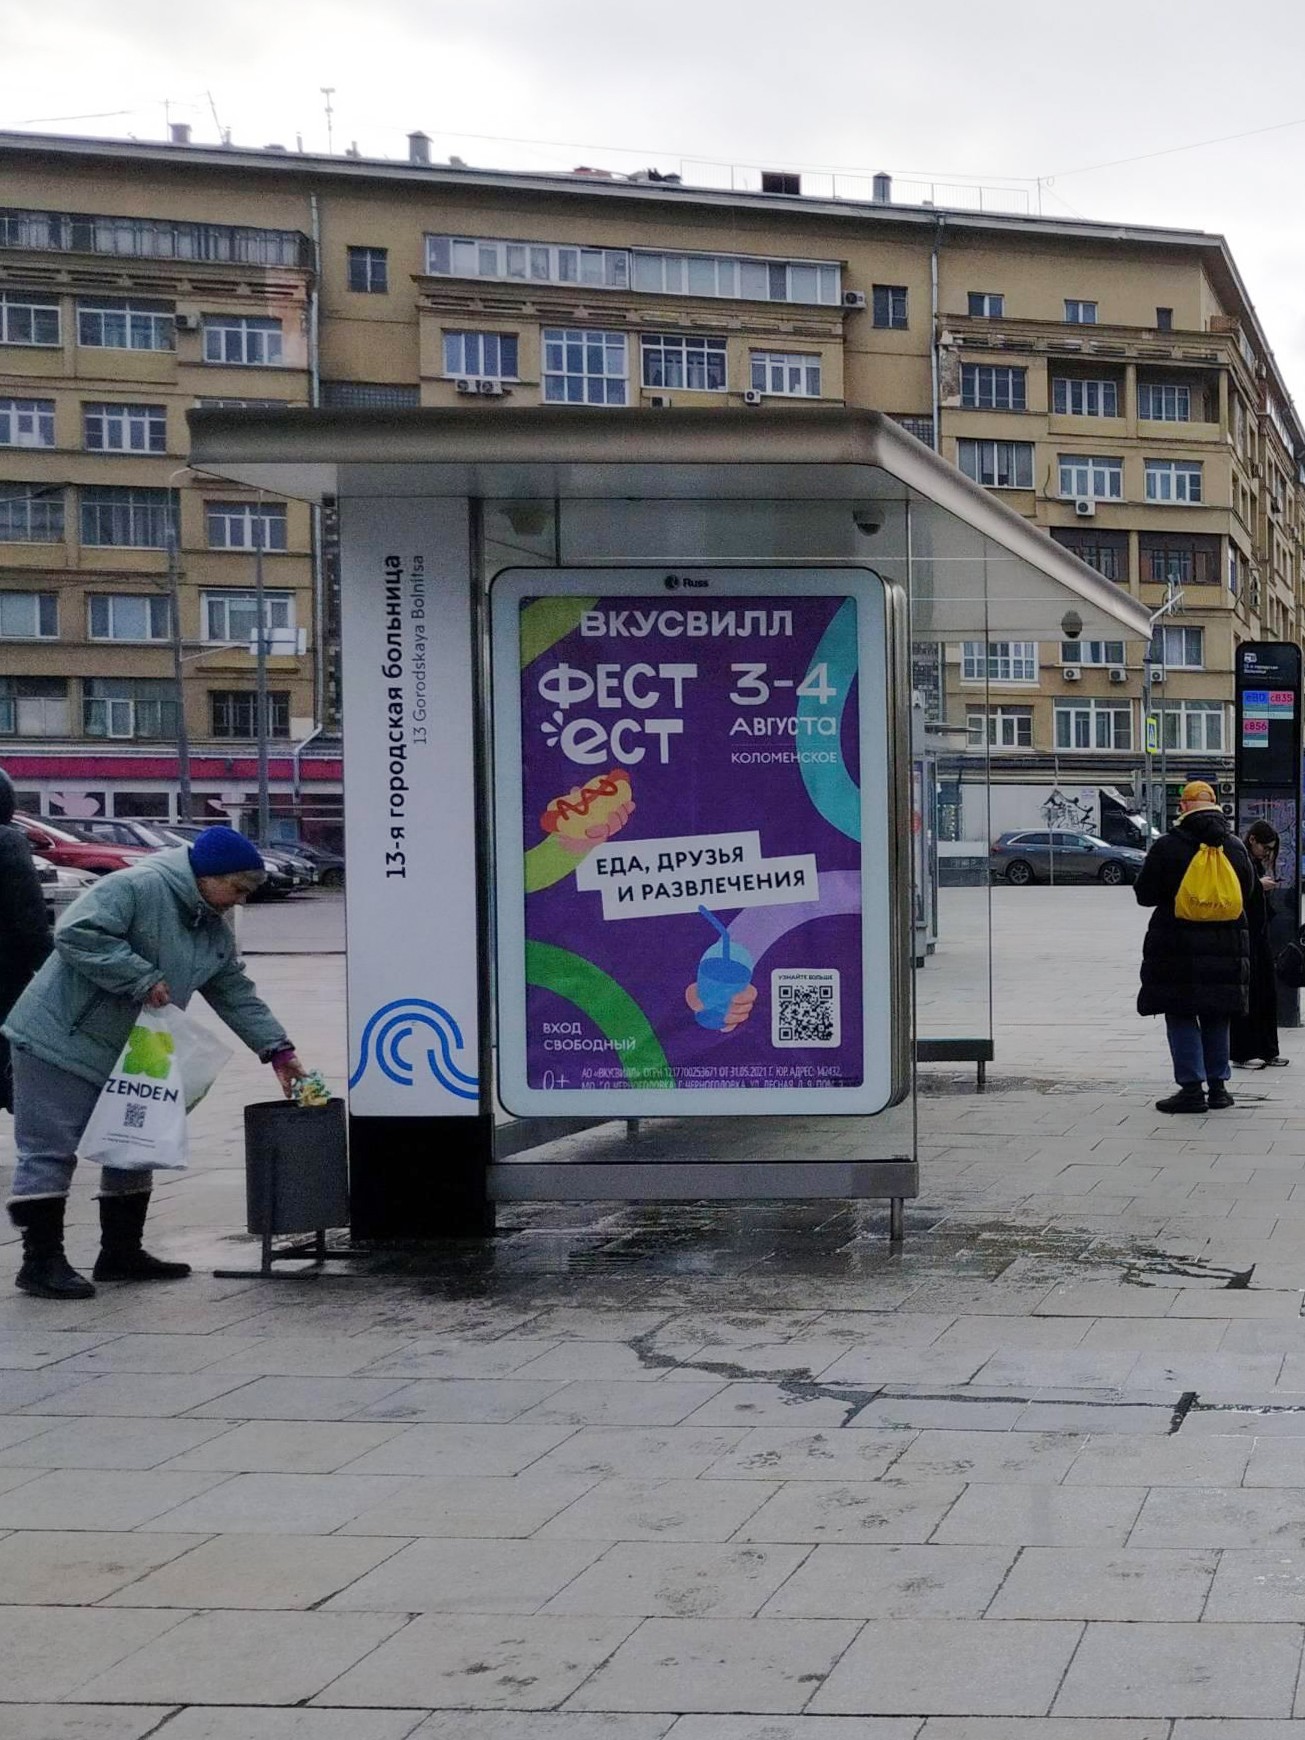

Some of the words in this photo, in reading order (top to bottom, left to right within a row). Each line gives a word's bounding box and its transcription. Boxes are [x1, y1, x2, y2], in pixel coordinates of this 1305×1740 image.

[410, 555, 425, 619] Bolnitsa
[682, 577, 709, 588] Russ
[382, 554, 402, 679] больница
[580, 610, 793, 637] ВКУСВИЛЛ
[411, 624, 429, 723] Gorodskaya
[538, 663, 698, 709] ФЕСТ
[729, 663, 837, 706] 3-4
[413, 727, 427, 744] 13
[386, 686, 409, 818] городская
[731, 752, 837, 764] КОЛОМЕНСКОЕ
[386, 826, 406, 879] 13-я
[596, 855, 650, 877] ЕДА,
[657, 846, 744, 873] ДРУЗЬЯ
[617, 886, 634, 903] И
[641, 870, 805, 902] РАЗВЛЕЧЕНИЯ
[543, 1022, 582, 1035] ВХОД
[543, 1036, 637, 1052] СВОБОДНЫЙ
[106, 1079, 179, 1102] ZENDEN
[542, 1070, 570, 1089] 0+
